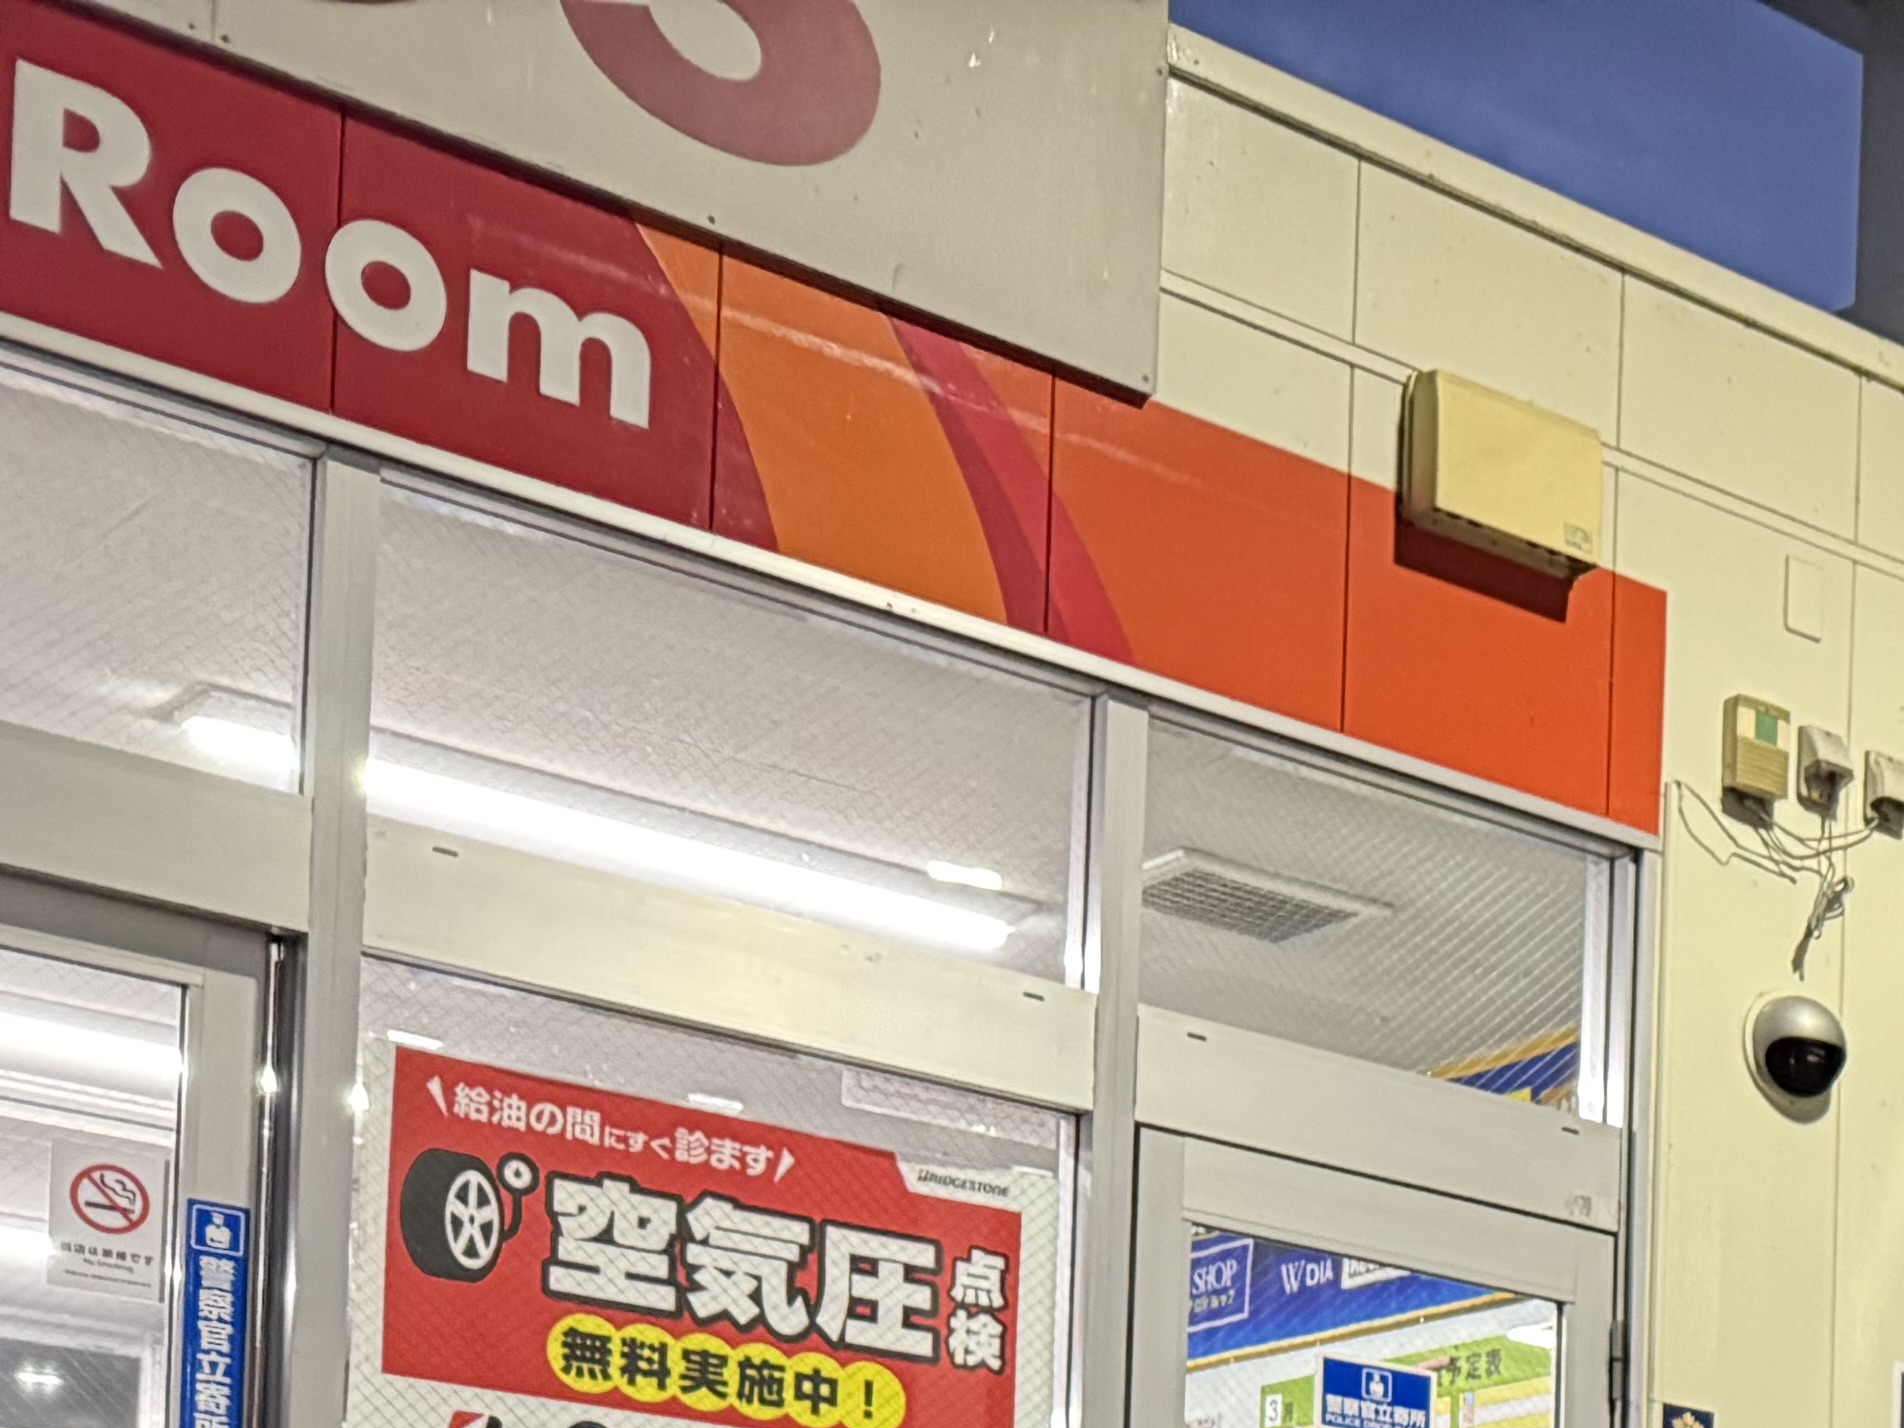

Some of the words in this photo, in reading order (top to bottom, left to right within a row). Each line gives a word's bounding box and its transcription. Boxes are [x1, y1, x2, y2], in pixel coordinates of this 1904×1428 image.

[9, 58, 651, 429] Room
[453, 1083, 773, 1177] 給油の間にすぐ診ます
[917, 1168, 1010, 1197] BRIDGESTONE
[545, 1173, 942, 1361] 空気圧
[948, 1244, 1010, 1374] 点検
[1192, 1259, 1238, 1295] SHOP
[561, 1327, 876, 1419] 無料実施中！
